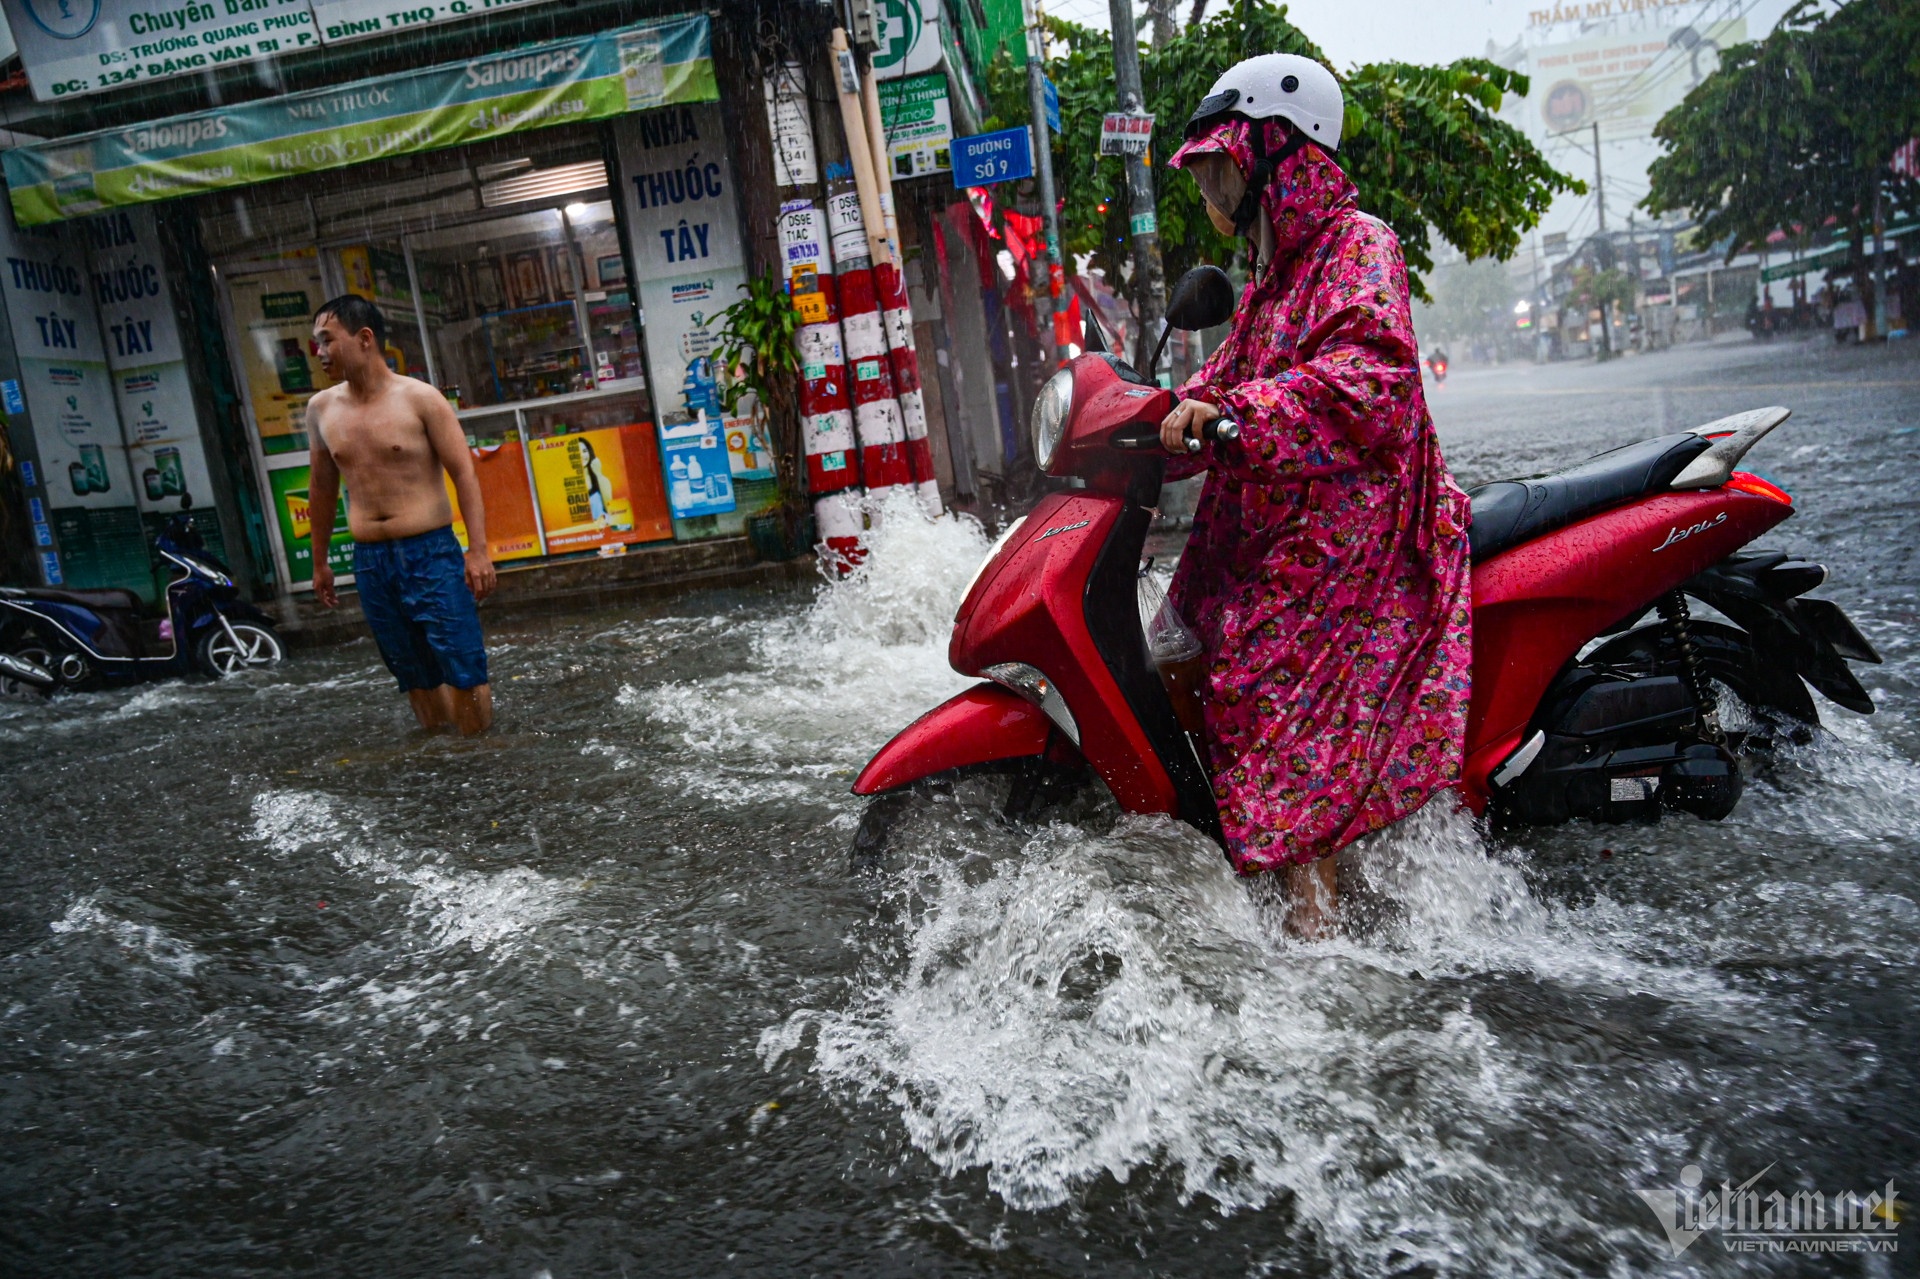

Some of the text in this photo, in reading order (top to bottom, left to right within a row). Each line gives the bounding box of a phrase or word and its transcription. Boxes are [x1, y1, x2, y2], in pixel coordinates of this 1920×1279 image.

[129, 0, 215, 34] Chuyên
[51, 79, 89, 96] ĐC:
[147, 54, 206, 76] ĐẶNG
[209, 43, 250, 63] VĂN
[257, 38, 280, 53] BI
[297, 32, 320, 46] P.
[326, 20, 381, 39] BÌNH
[386, 6, 435, 24] THỌ
[450, 0, 473, 13] Q.
[99, 52, 127, 66] DS:
[202, 22, 260, 44] QUANG
[465, 47, 581, 90] Salonpas
[122, 115, 228, 154] Salonpas
[968, 138, 1011, 157] ĐƯỜNG
[632, 152, 722, 209] THUỐC
[974, 155, 1008, 179] SỐ 9
[786, 228, 808, 242] T1AC
[788, 213, 812, 227] DS9E
[841, 210, 858, 223] T1C
[660, 219, 709, 263] TÂY
[7, 254, 81, 296] THUỐC
[35, 311, 77, 349] TÂY
[110, 316, 153, 356] TÂY
